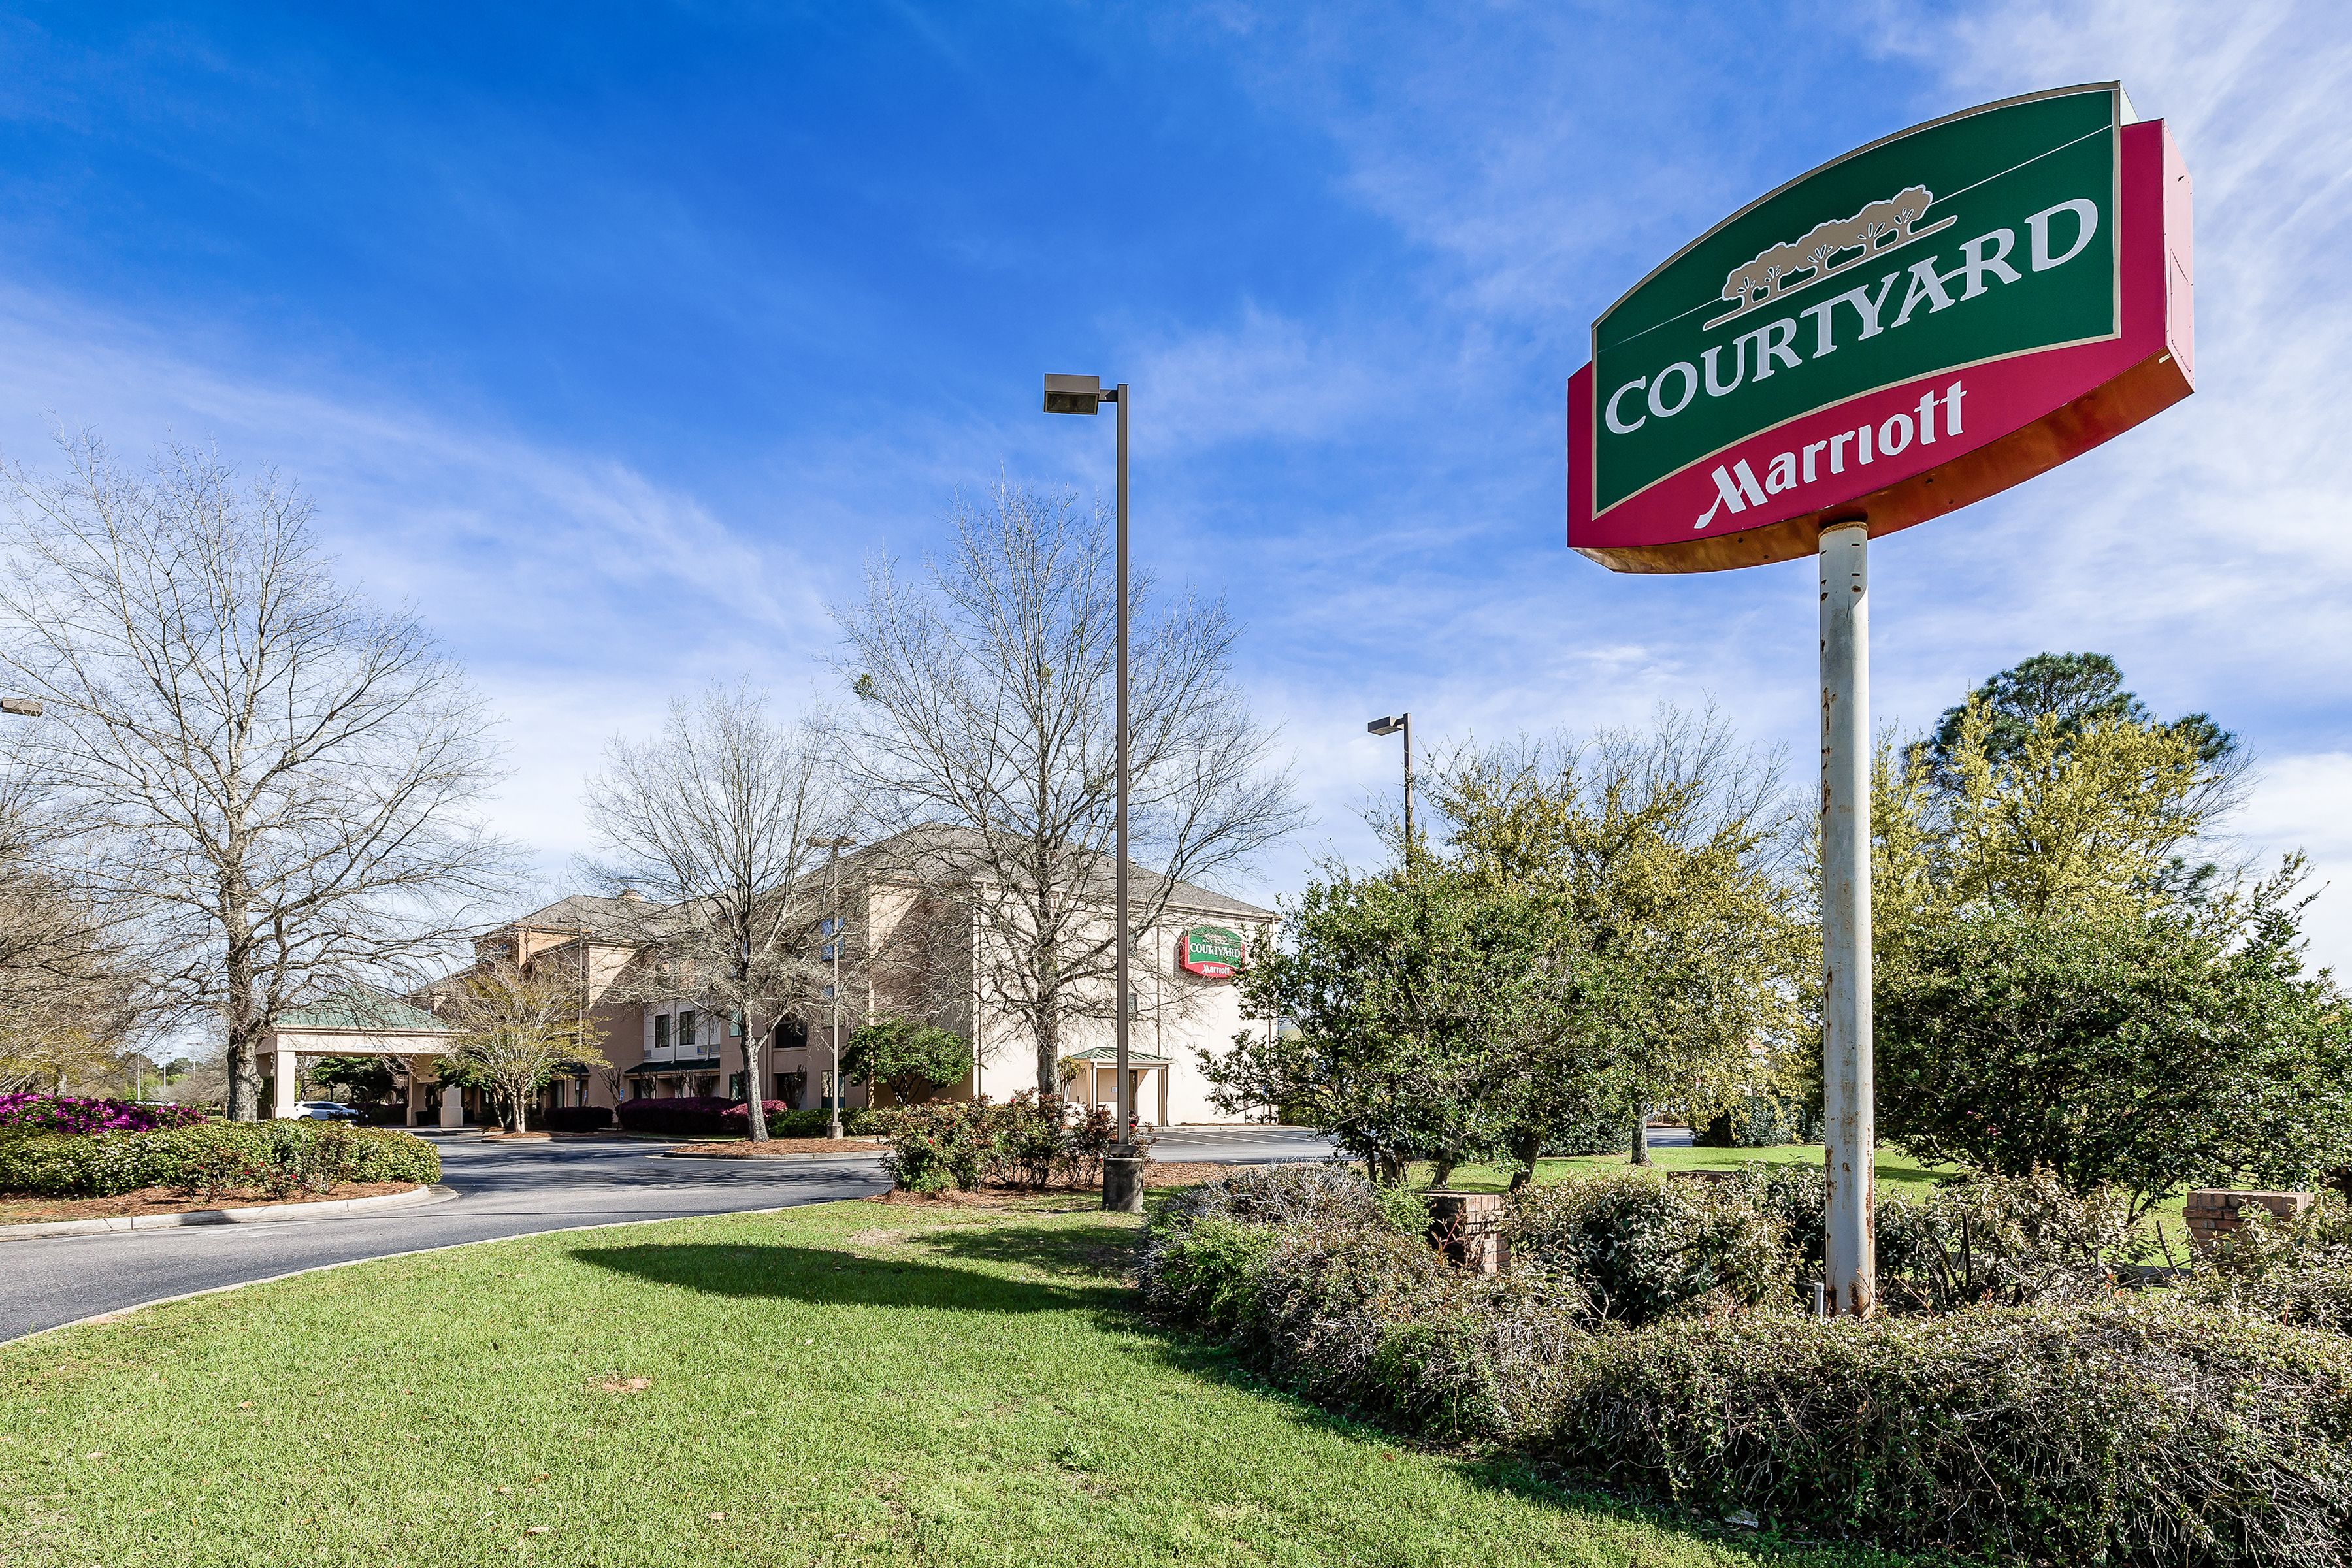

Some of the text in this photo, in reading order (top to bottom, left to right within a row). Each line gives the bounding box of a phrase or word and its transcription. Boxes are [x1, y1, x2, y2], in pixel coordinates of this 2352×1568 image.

[1605, 198, 2099, 434] COURTYARD
[1693, 380, 1967, 529] Marriott
[1190, 943, 1240, 958] COURTYARD
[1202, 964, 1230, 975] Marriott
